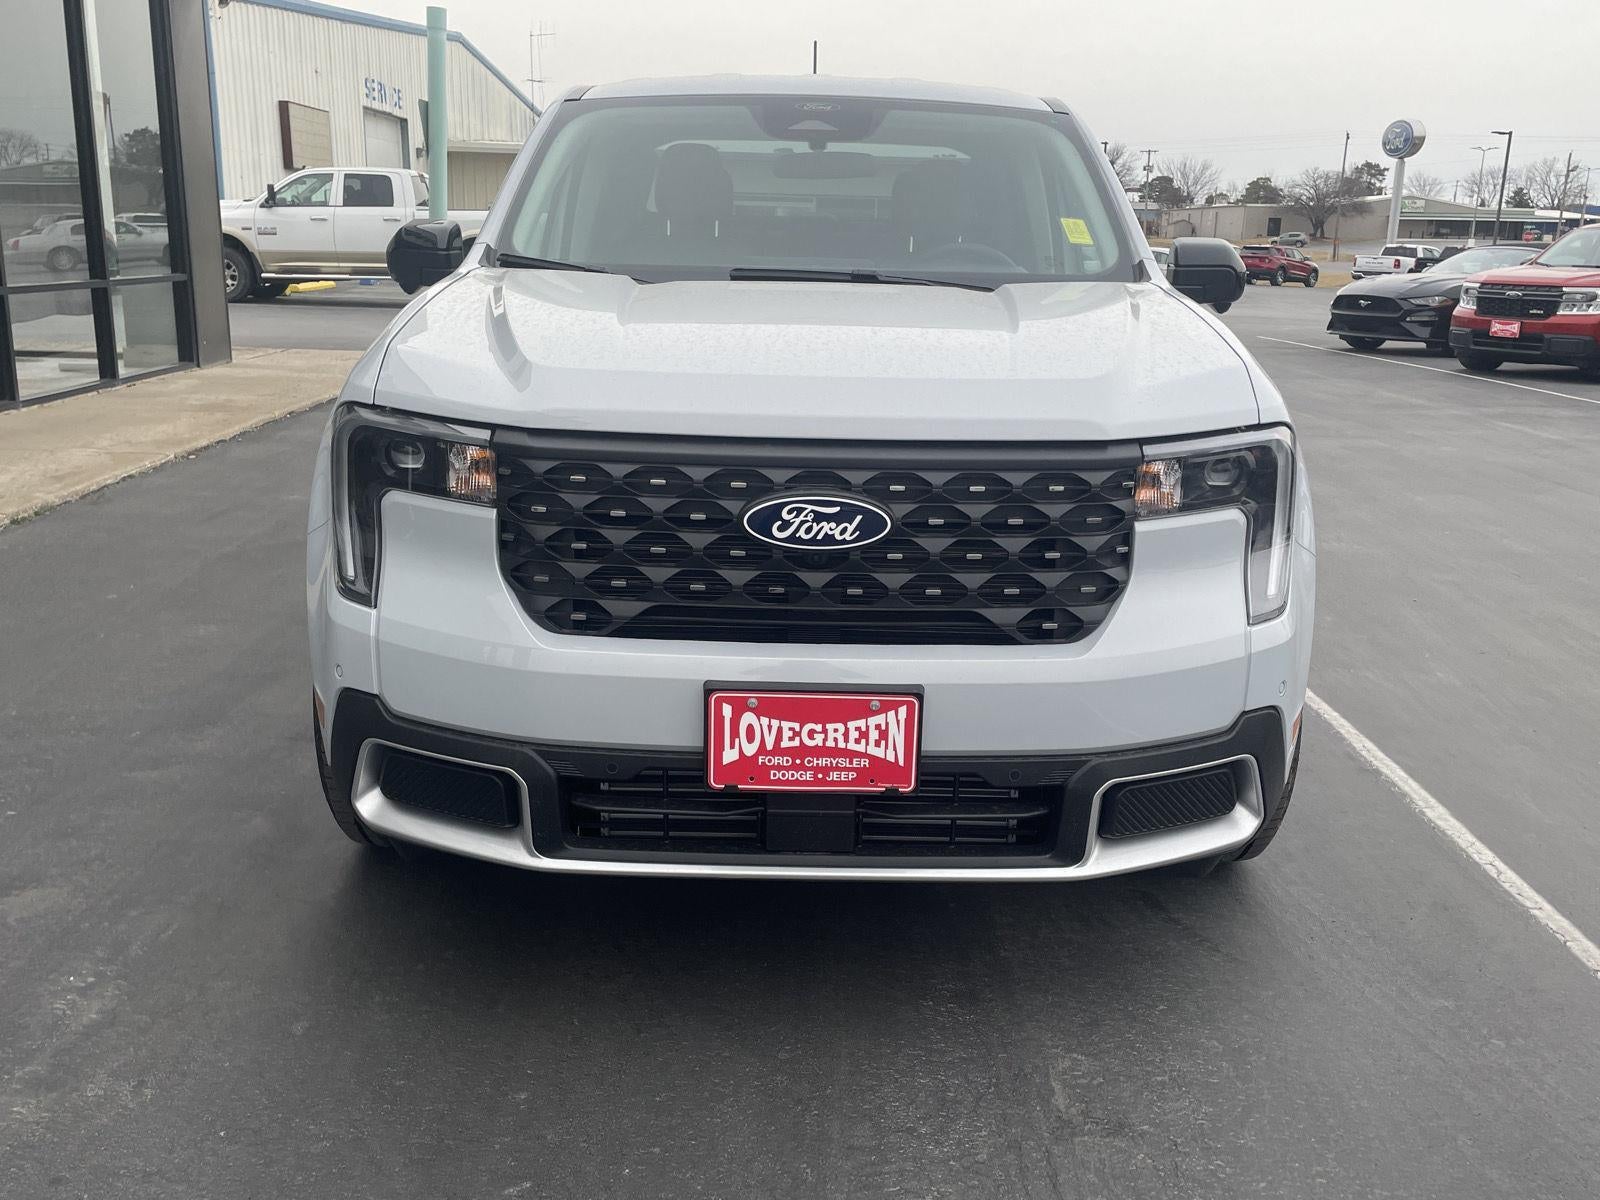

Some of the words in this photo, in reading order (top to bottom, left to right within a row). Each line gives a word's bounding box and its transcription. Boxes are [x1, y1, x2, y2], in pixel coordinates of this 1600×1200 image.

[1385, 127, 1406, 150] Ford
[771, 503, 863, 541] Ford
[722, 702, 908, 767] LOVEGREEN
[758, 755, 792, 767] FORD
[804, 757, 870, 768] CHRYSLER
[770, 770, 814, 781] DODGE
[826, 772, 857, 782] JEEP
